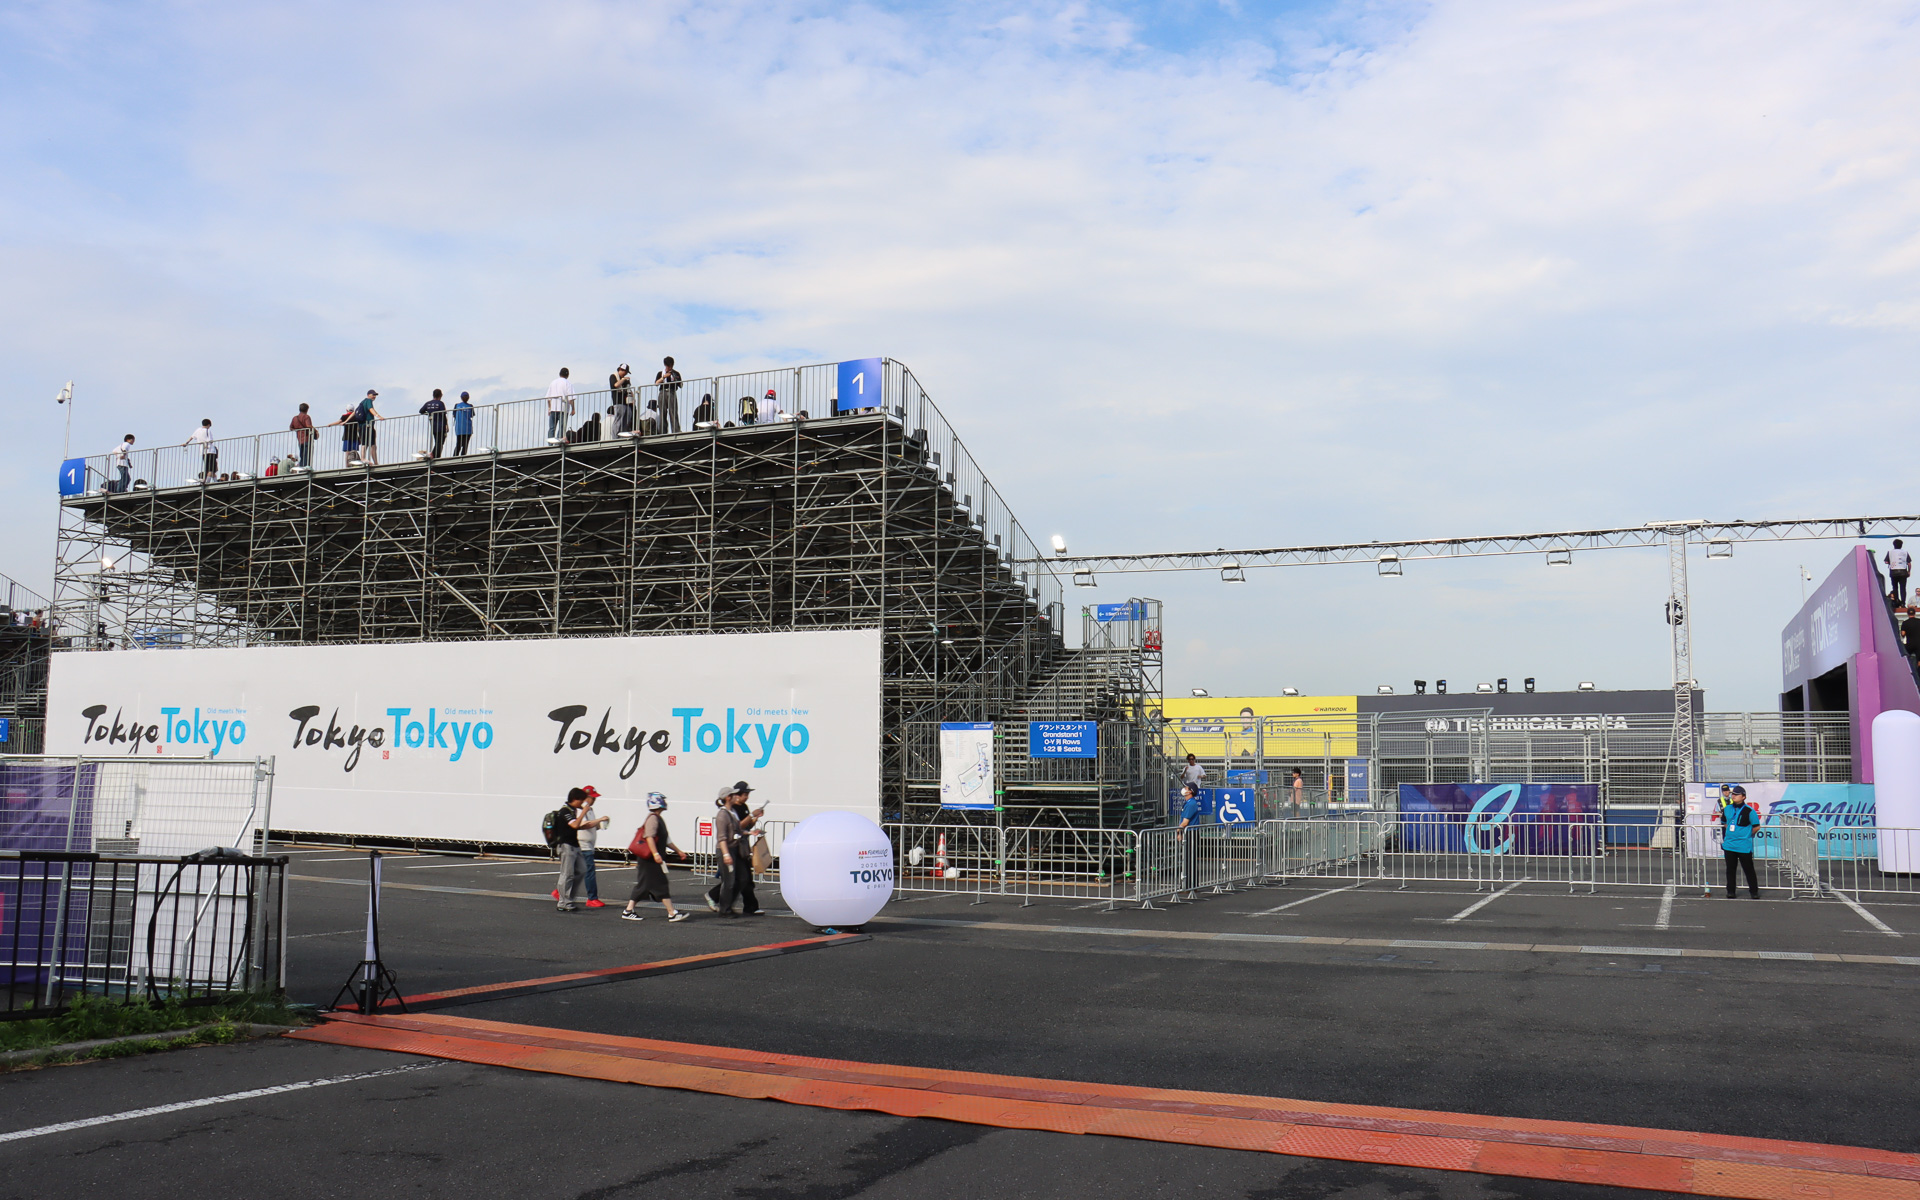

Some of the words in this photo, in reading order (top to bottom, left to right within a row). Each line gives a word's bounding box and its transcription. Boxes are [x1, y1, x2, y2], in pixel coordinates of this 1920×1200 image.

[852, 372, 864, 395] 1
[67, 468, 76, 485] 1
[81, 704, 160, 755] Tokyo
[160, 707, 247, 756] Tokyo
[386, 707, 494, 762] Tokyo
[746, 707, 761, 716] Old
[764, 708, 788, 716] meets
[791, 708, 809, 716] New
[288, 705, 385, 773] Tokyo
[547, 704, 671, 780] Tokyo
[672, 707, 810, 769] Tokyo
[1239, 790, 1246, 803] 1
[850, 868, 892, 883] TOKYO
